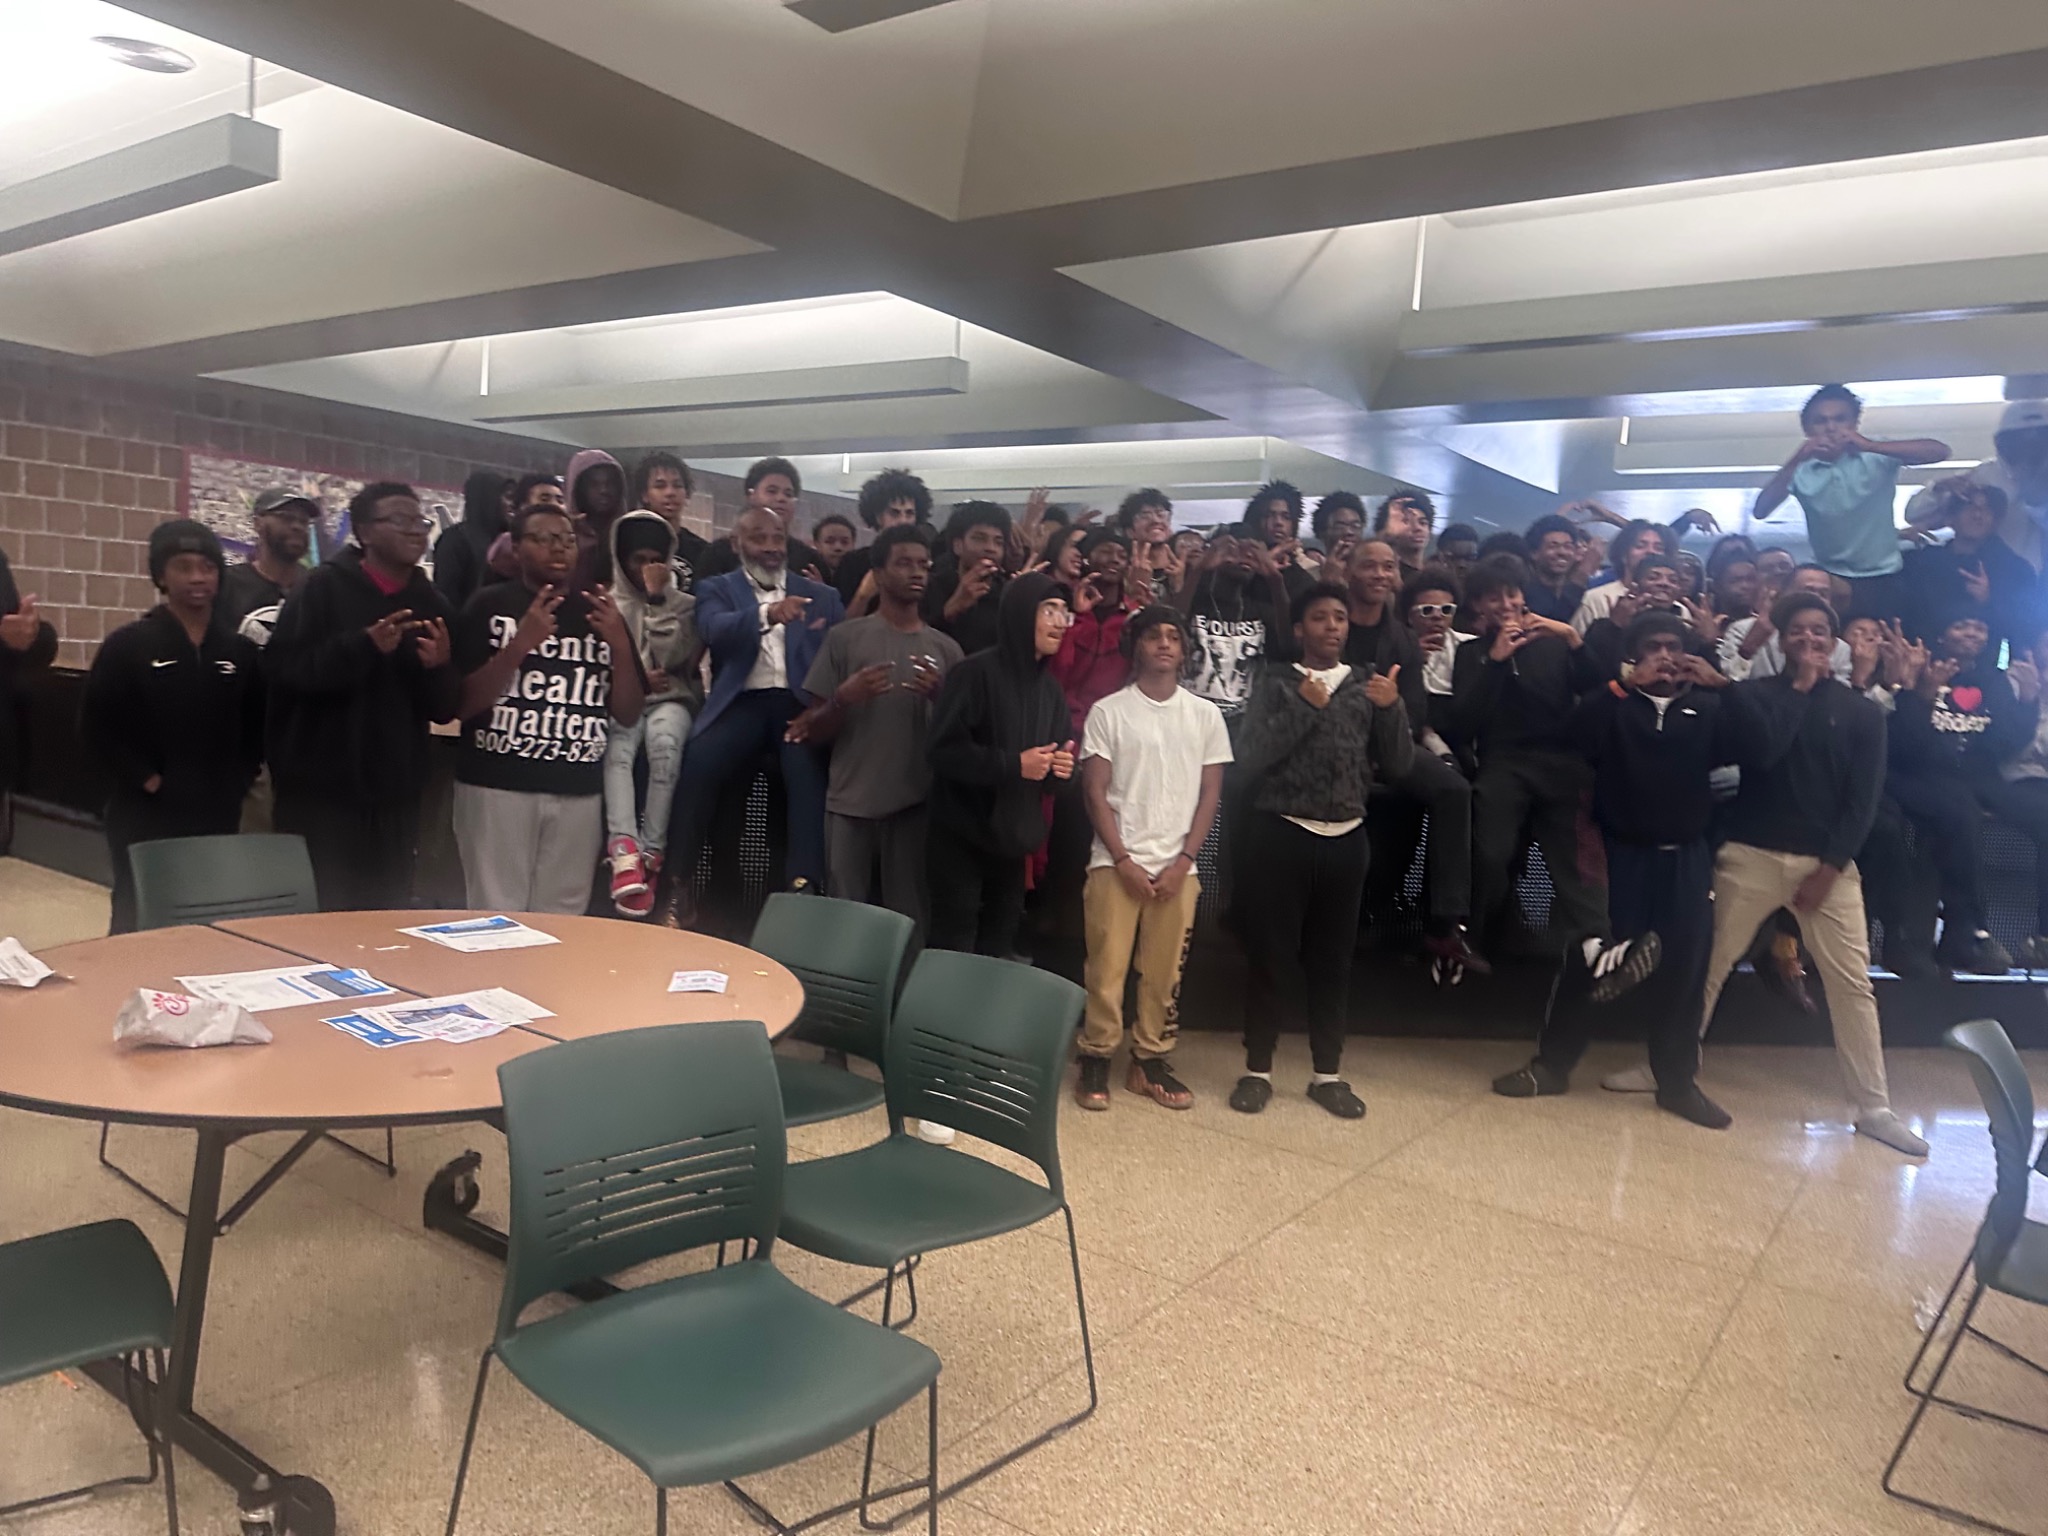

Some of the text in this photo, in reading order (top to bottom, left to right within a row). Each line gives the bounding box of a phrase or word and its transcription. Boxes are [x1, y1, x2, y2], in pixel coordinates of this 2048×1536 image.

[489, 615, 612, 666] Menta
[475, 729, 607, 763] 800-273-82
[490, 705, 608, 746] matters
